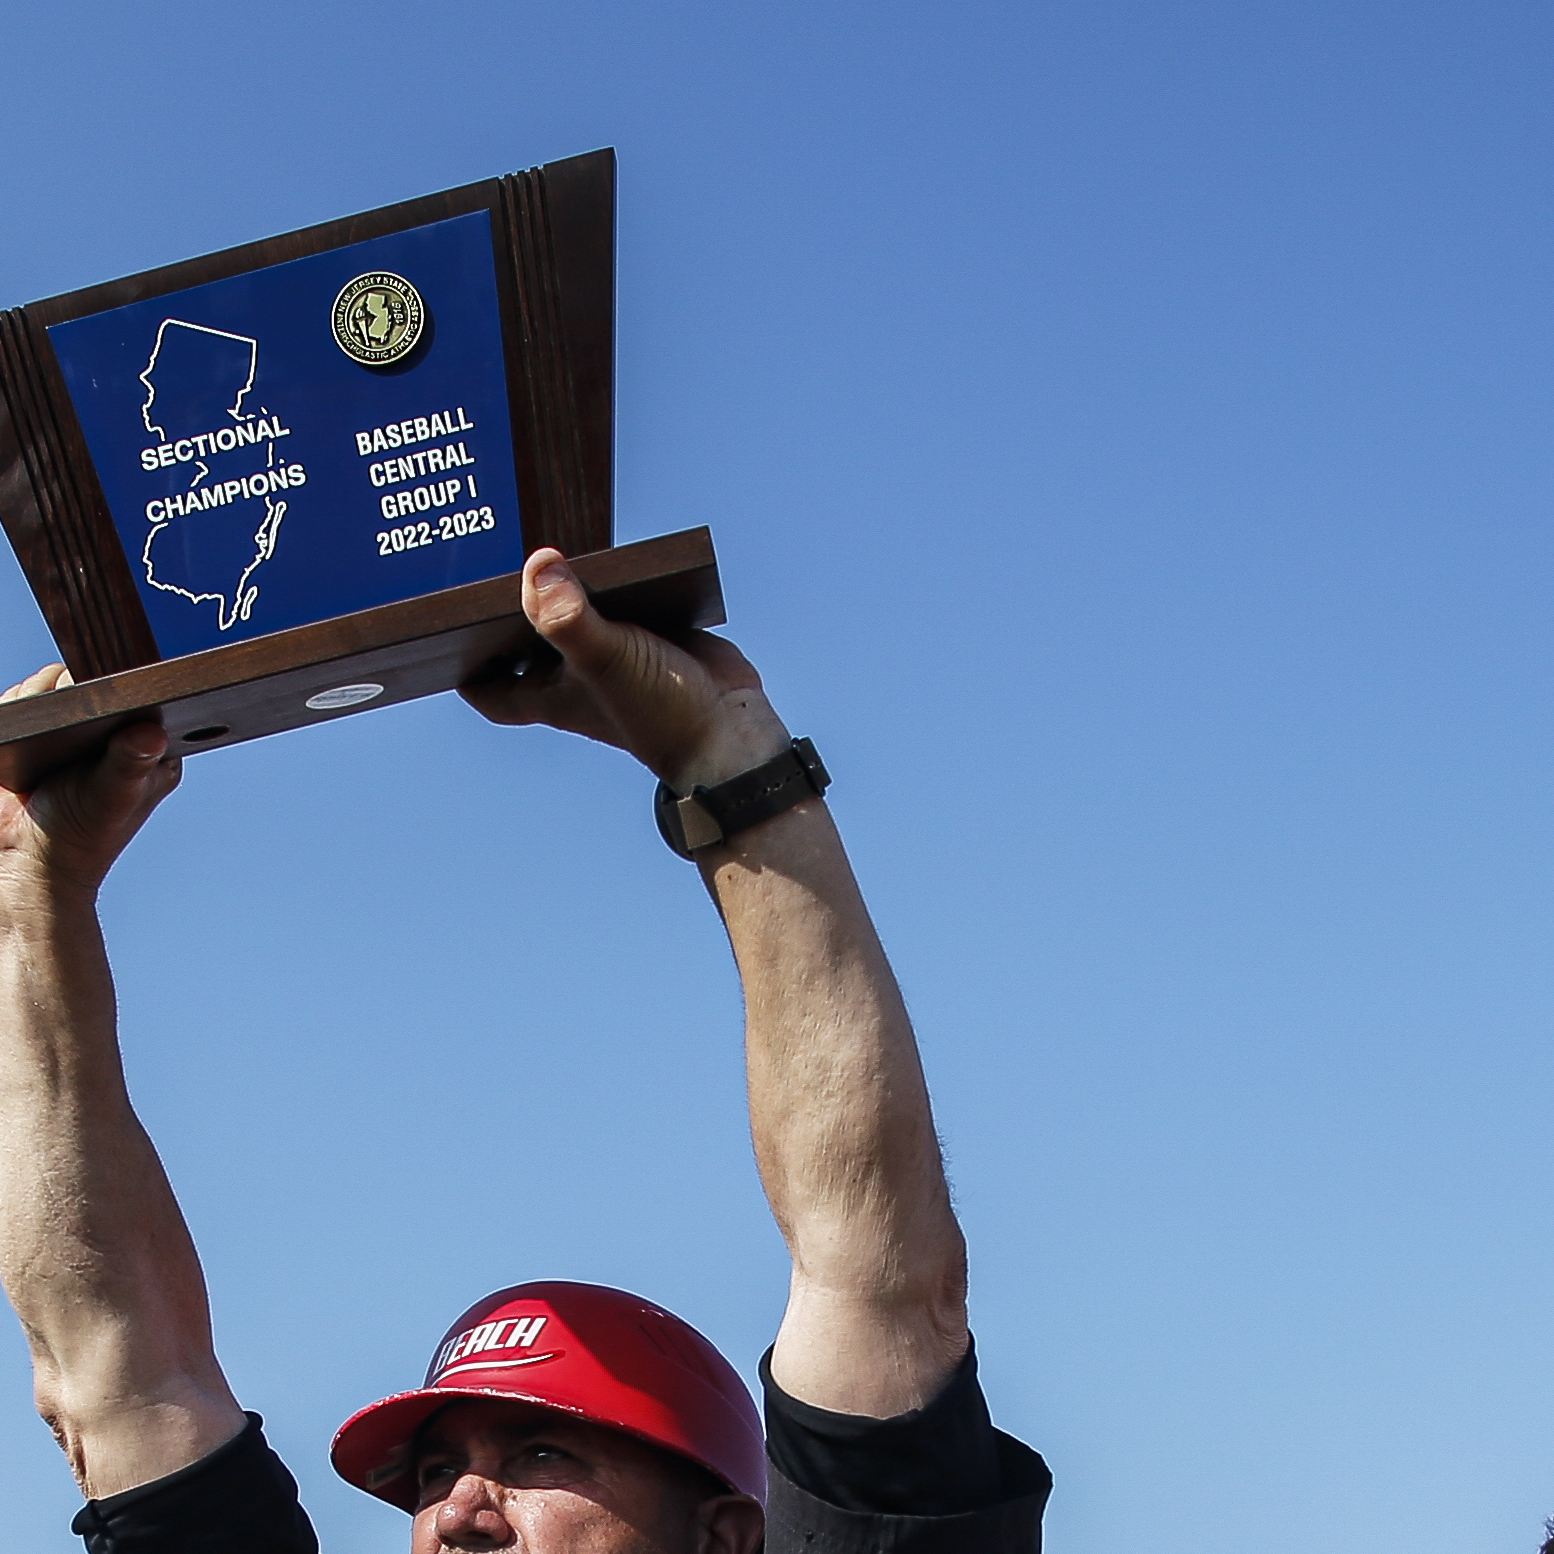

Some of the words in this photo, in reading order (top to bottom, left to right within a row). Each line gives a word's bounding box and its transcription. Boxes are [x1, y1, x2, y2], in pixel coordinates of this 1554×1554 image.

[140, 415, 291, 471] SECTIONAL
[355, 406, 475, 457] BASEBALL
[369, 441, 476, 488] CENTRAL
[146, 464, 307, 523] CHAMPIONS
[380, 478, 462, 520] GROUP
[466, 474, 478, 499] I
[376, 506, 496, 556] 2022-2023
[432, 1316, 548, 1378] BEACH
